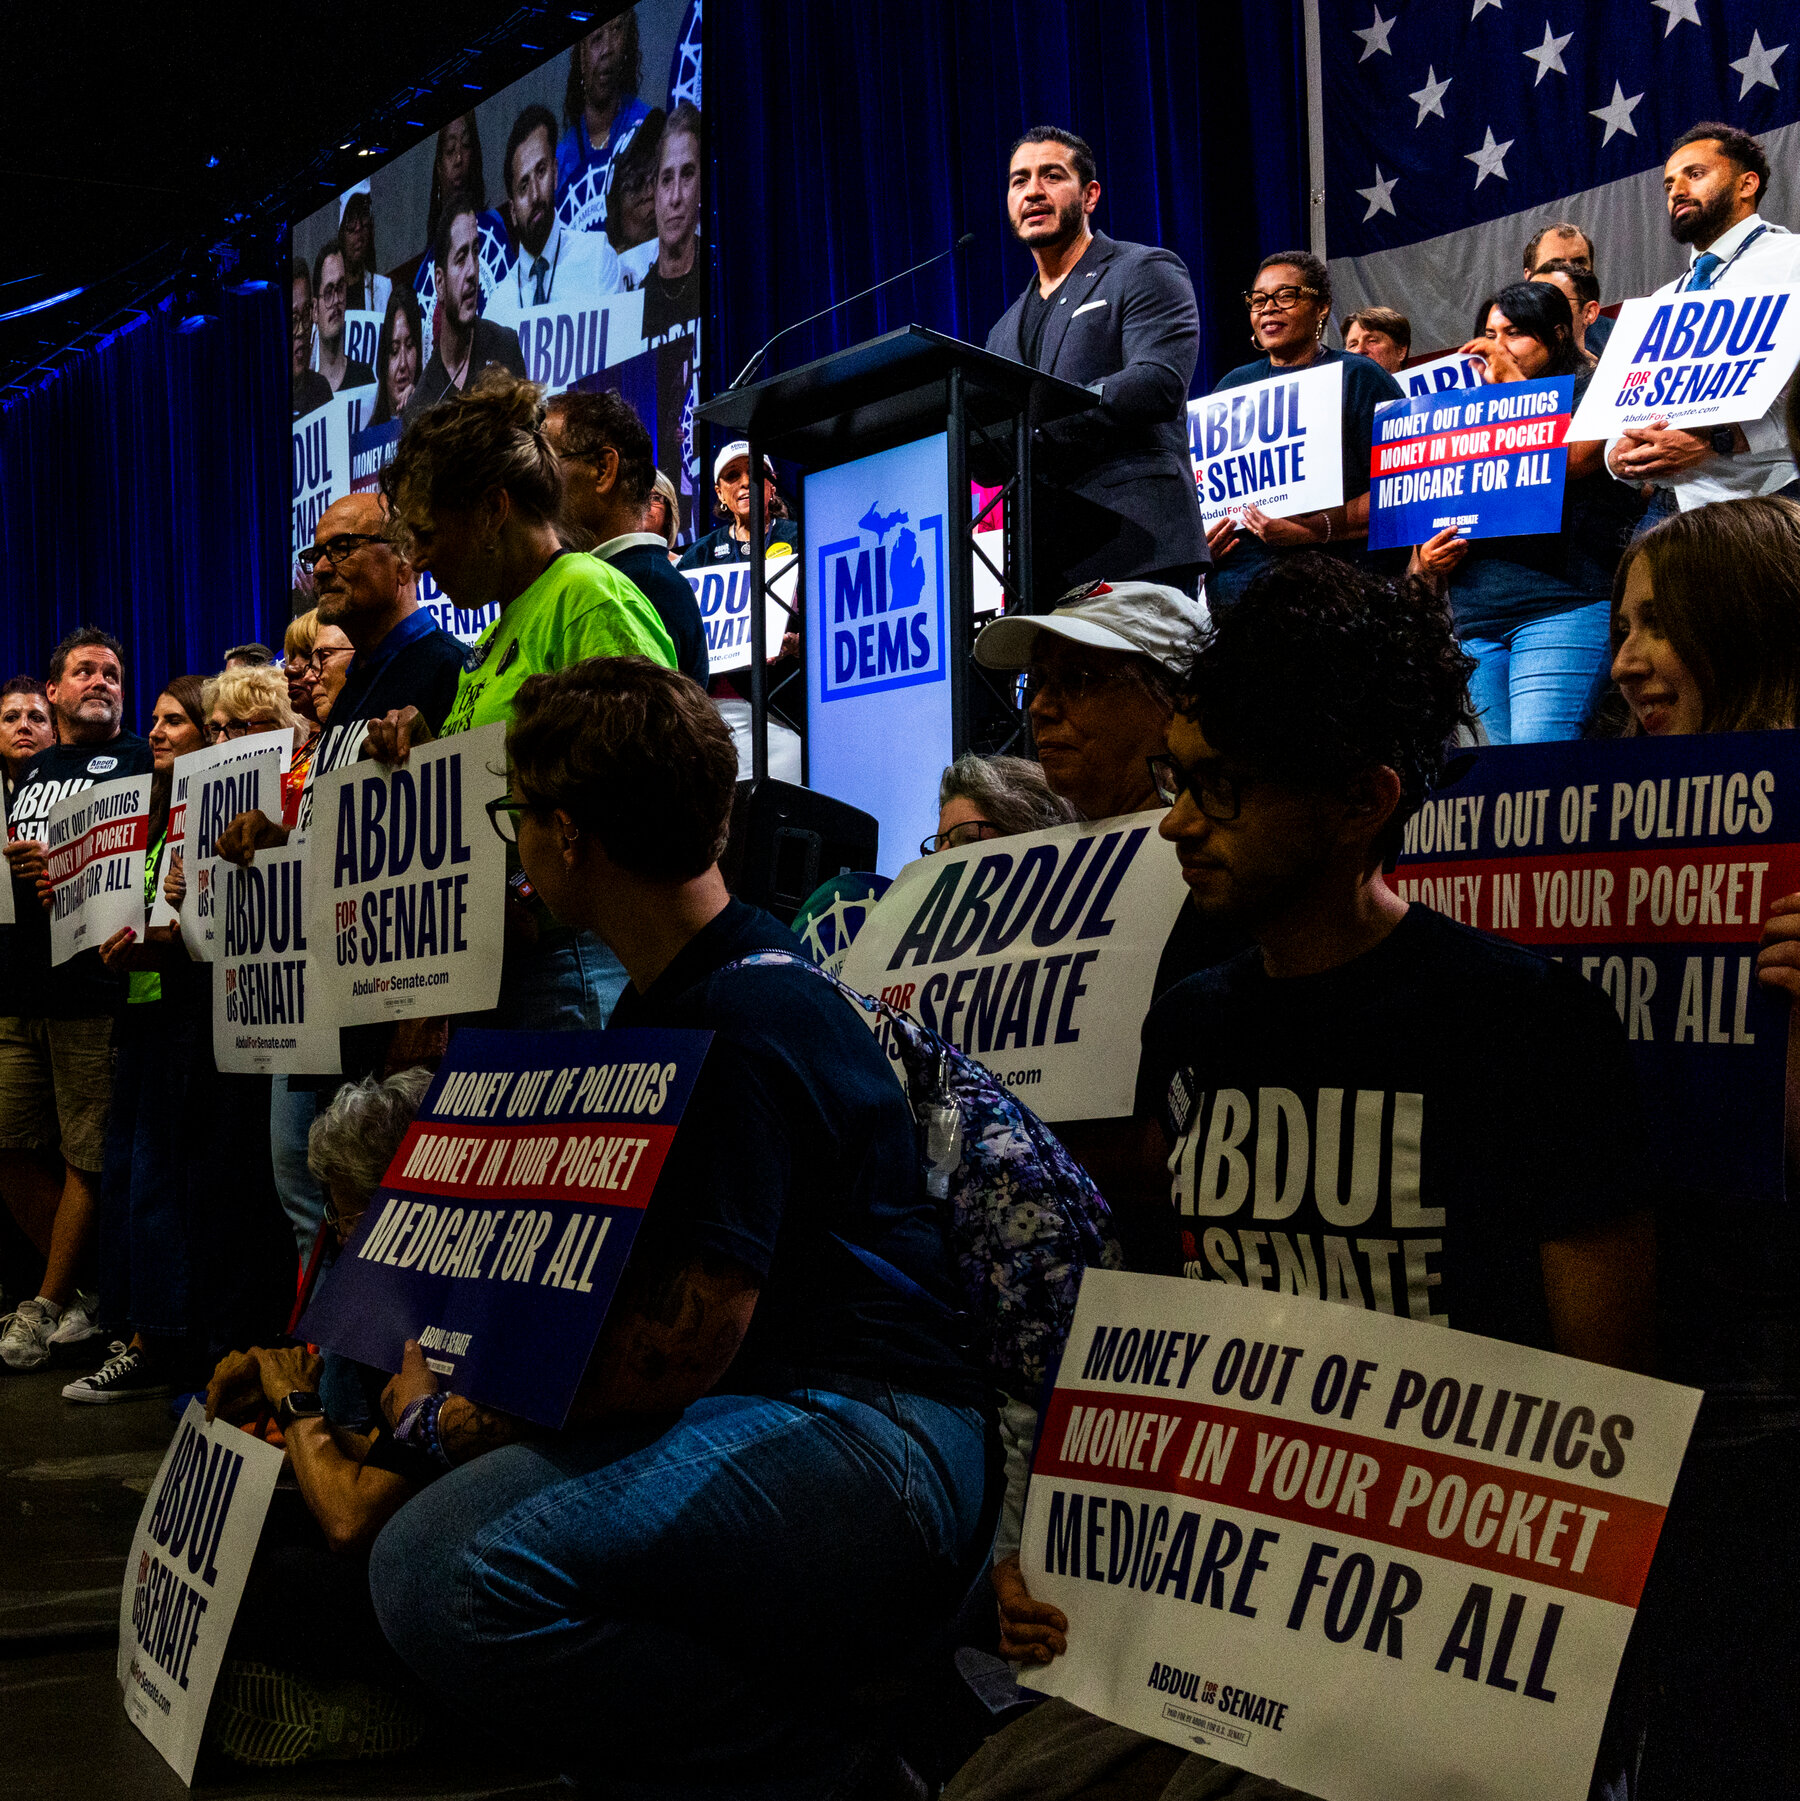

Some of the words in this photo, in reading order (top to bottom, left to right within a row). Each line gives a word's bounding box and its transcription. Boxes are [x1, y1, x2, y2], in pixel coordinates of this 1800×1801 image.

[1631, 293, 1791, 364] ABDUL
[1615, 385, 1645, 407] US
[1623, 371, 1651, 389] FOR
[1644, 357, 1767, 407] SENATE
[1187, 382, 1306, 462] ABDUL
[1382, 412, 1429, 441] MONEY
[1433, 405, 1461, 431] OUT
[1465, 401, 1484, 425] OF
[1488, 390, 1559, 422] POLITICS
[1621, 405, 1720, 423] AbdulForSenate.com
[353, 446, 382, 480] MONEY
[1207, 441, 1306, 503] SENATE
[1380, 440, 1429, 471] MONEY
[1430, 437, 1447, 461] IN
[1451, 430, 1490, 457] YOUR
[1494, 420, 1556, 451] POCKET
[1378, 465, 1465, 509] MEDICARE
[1471, 459, 1510, 493] FOR
[1515, 453, 1552, 487] ALL
[834, 545, 887, 624] MI
[834, 612, 931, 684] DEMS
[72, 809, 86, 837] OUT
[93, 789, 139, 823] POLITICS
[95, 822, 137, 852] POCKET
[334, 753, 471, 888] ABDUL
[1493, 789, 1552, 848] OUT
[1559, 784, 1599, 844] OF
[1609, 770, 1775, 841] POLITICS
[86, 864, 102, 898] FOR
[105, 857, 132, 892] ALL
[198, 869, 209, 893] FOR
[198, 891, 209, 917] US
[886, 827, 1151, 971] ABDUL
[1492, 873, 1520, 929] IN
[1532, 868, 1615, 928] YOUR
[1626, 862, 1770, 926] POCKET
[225, 860, 307, 957] ABDUL
[335, 899, 357, 933] FOR
[361, 873, 469, 967] SENATE
[336, 928, 358, 967] US
[226, 968, 237, 994] FOR
[226, 990, 238, 1022] US
[352, 970, 449, 997] AbdulForSenate.com
[875, 982, 916, 1023] FOR
[919, 950, 1100, 1055] SENATE
[1674, 956, 1755, 1044] ALL
[235, 1036, 297, 1050] AbdulForSenate.com
[432, 1071, 514, 1118] MONEY
[505, 1069, 554, 1118] OUT
[543, 1066, 580, 1116] OF
[568, 1062, 677, 1116] POLITICS
[401, 1134, 487, 1185] MONEY
[476, 1139, 512, 1187] IN
[502, 1136, 559, 1186] YOUR
[549, 1135, 650, 1191] POCKET
[1167, 1087, 1447, 1228] ABDUL
[357, 1198, 505, 1280] MEDICARE
[488, 1209, 553, 1283] FOR
[540, 1213, 612, 1293] ALL
[1202, 1227, 1450, 1328] SENATE
[417, 1325, 447, 1351] ABDUL
[446, 1331, 473, 1357] SENATE
[1081, 1326, 1210, 1389] MONEY
[1211, 1338, 1304, 1405] OUT
[1310, 1353, 1379, 1420] OF
[1384, 1368, 1635, 1479] POLITICS
[147, 1421, 244, 1588] ABDUL
[1059, 1404, 1180, 1472] MONEY
[1181, 1419, 1240, 1485] IN
[1247, 1431, 1381, 1520] YOUR
[1388, 1465, 1610, 1574] POCKET
[137, 1556, 208, 1692] SENATE
[1045, 1491, 1281, 1619] MEDICARE
[1286, 1541, 1423, 1660] FOR
[1434, 1582, 1566, 1704] ALL
[1147, 1661, 1201, 1703] ABDUL
[1201, 1691, 1216, 1705] US
[1204, 1681, 1219, 1692] FOR
[1218, 1685, 1289, 1732] SENATE
